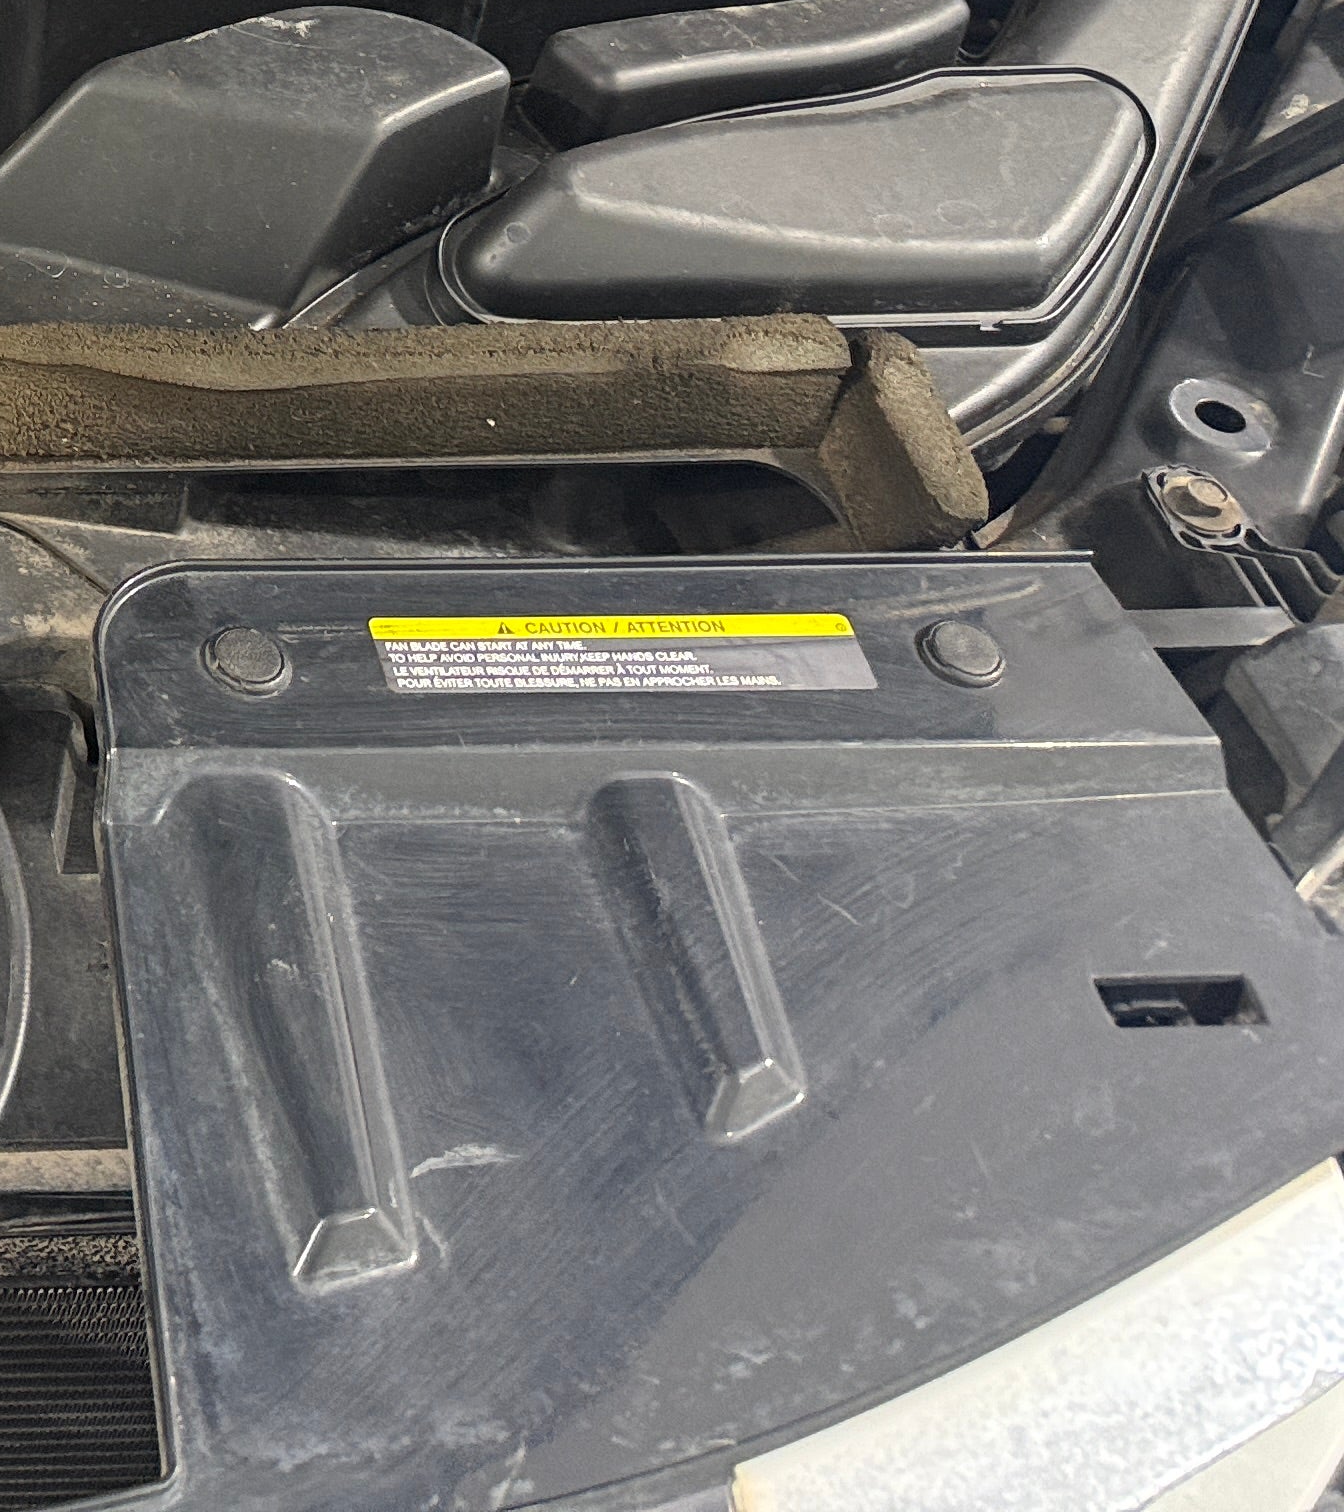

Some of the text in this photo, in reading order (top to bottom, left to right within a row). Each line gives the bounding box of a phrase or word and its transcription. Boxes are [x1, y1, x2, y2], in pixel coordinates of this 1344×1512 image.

[525, 621, 605, 634] CAUTION
[628, 620, 725, 633] ATTENTION
[385, 640, 587, 651] FAN BLADE CAN START AT ANY TIME.
[388, 653, 404, 663] TO
[407, 653, 437, 663] HELP
[440, 653, 476, 663] AVOID
[477, 653, 540, 663] PERSONAL
[612, 651, 654, 661] HANDS
[655, 651, 697, 661] CLEAR.
[393, 666, 409, 676] LE
[411, 666, 486, 676] VENTILATEUR
[486, 666, 529, 676] RISQUE
[532, 666, 549, 676] DE
[551, 663, 615, 676] DÉMARRER
[626, 665, 658, 675] TOUT
[660, 664, 714, 675] MOMENT.
[397, 676, 781, 688] POUR ÉVITER TOUTE BLESSURE, NE PAS EN APPROCHER LES MAINS.
